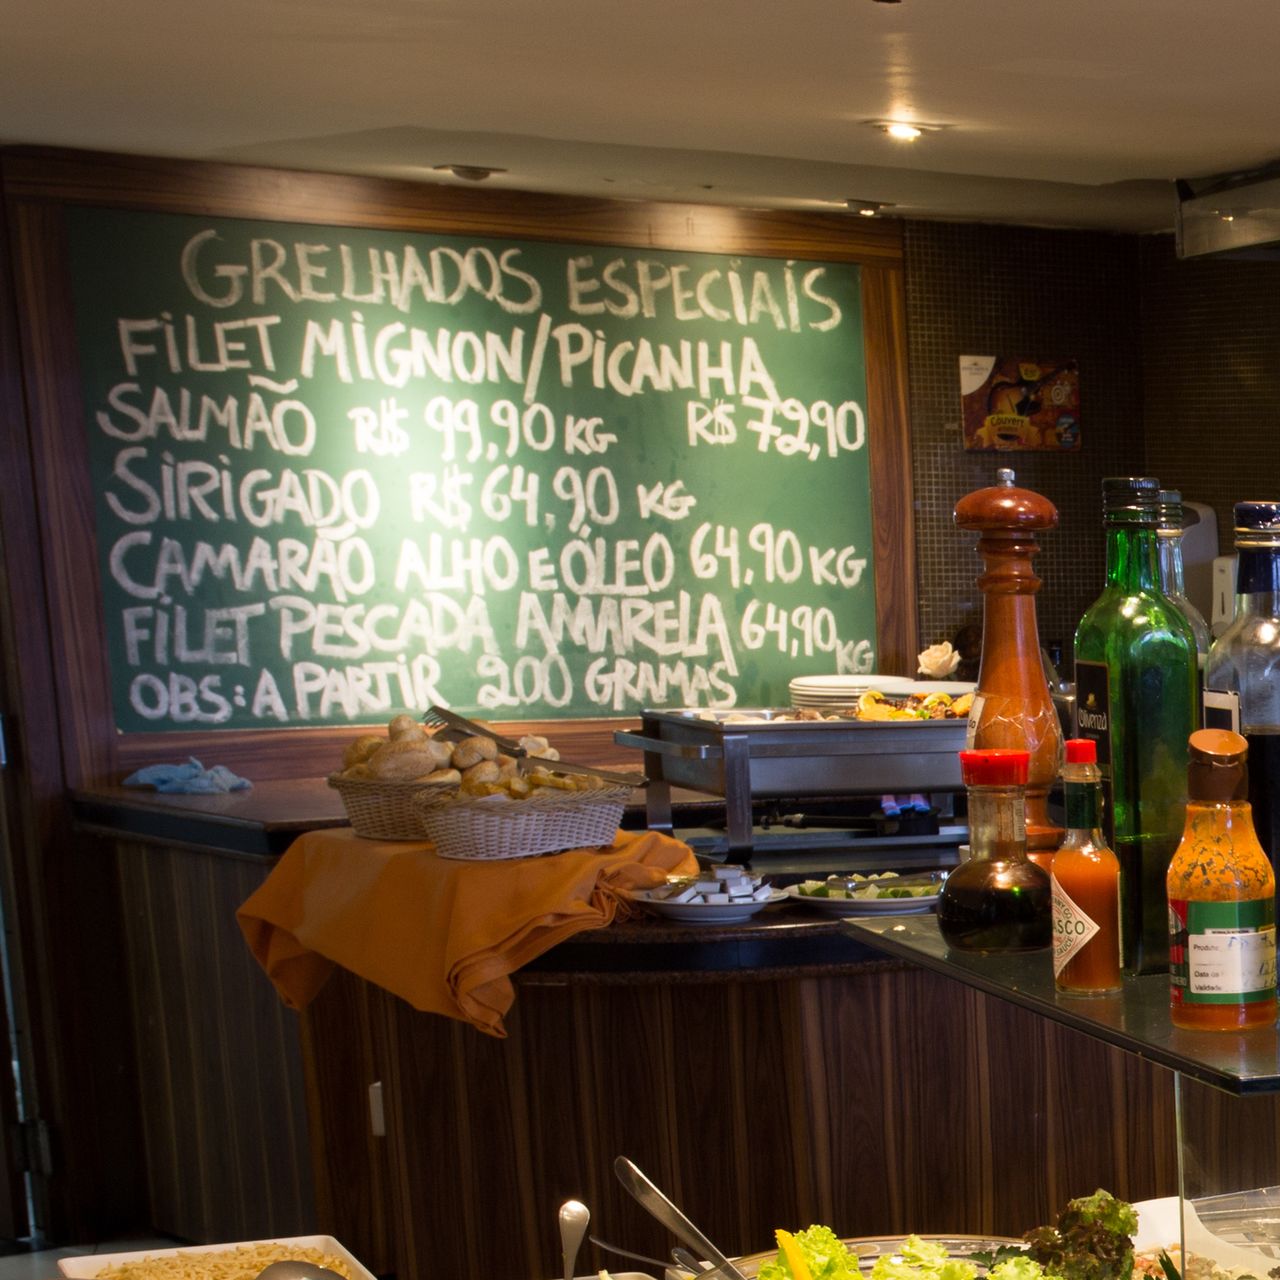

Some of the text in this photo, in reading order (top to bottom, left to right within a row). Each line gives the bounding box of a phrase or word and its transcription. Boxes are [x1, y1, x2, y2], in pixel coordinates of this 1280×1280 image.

[181, 229, 842, 332] GRELHADOS ESPECIAIS
[118, 311, 281, 376] FILET
[97, 374, 618, 462] SALMÃO R$ 99,90 KG
[687, 398, 738, 447] R$
[105, 447, 697, 533] SIRIGADO R$ 64,90 KG
[110, 520, 375, 602] CAMARÃO
[395, 533, 519, 595] ALHO
[690, 522, 802, 588] 64,90
[809, 546, 867, 588] KG
[123, 589, 873, 677] FILET PESCADA AMARELA 64,90 KG
[293, 653, 450, 720] PARTIR
[477, 652, 573, 710] 200
[585, 656, 737, 711] GRAMAS
